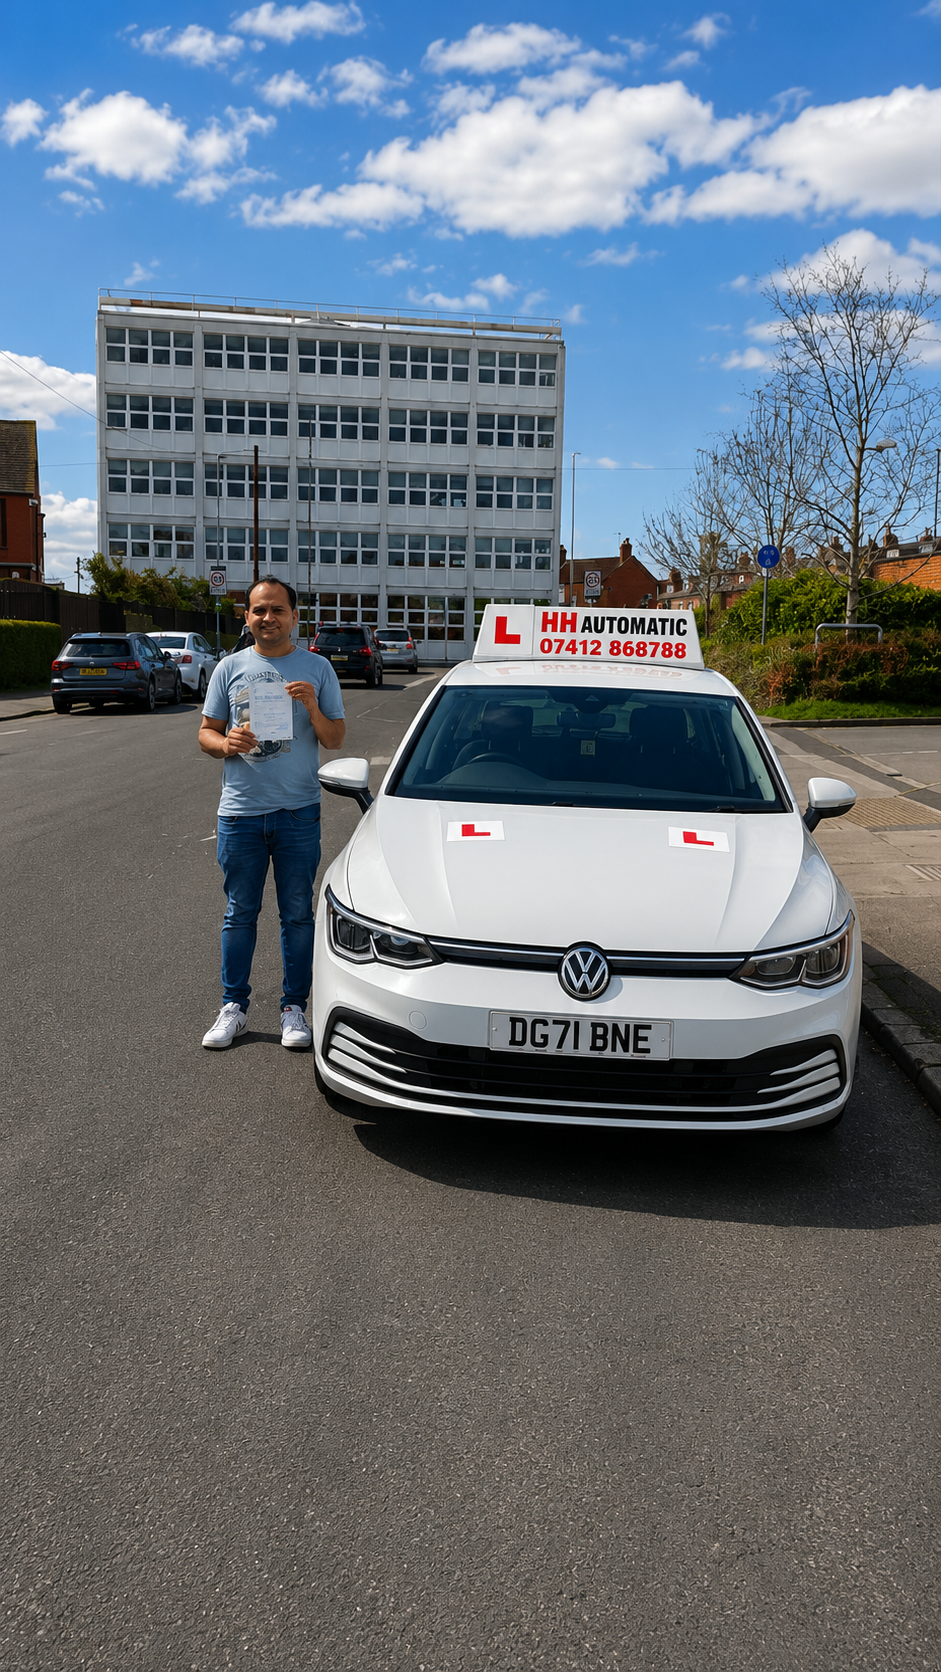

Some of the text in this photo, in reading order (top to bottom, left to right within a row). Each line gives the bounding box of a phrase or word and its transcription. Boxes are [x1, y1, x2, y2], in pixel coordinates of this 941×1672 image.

[494, 616, 521, 644] L
[541, 611, 688, 637] HH AUTOMATIC
[540, 638, 687, 659] 07412 868788
[461, 824, 491, 837] L
[683, 831, 714, 846] L
[562, 948, 608, 996] VW
[508, 1016, 652, 1054] DG71 BNE
